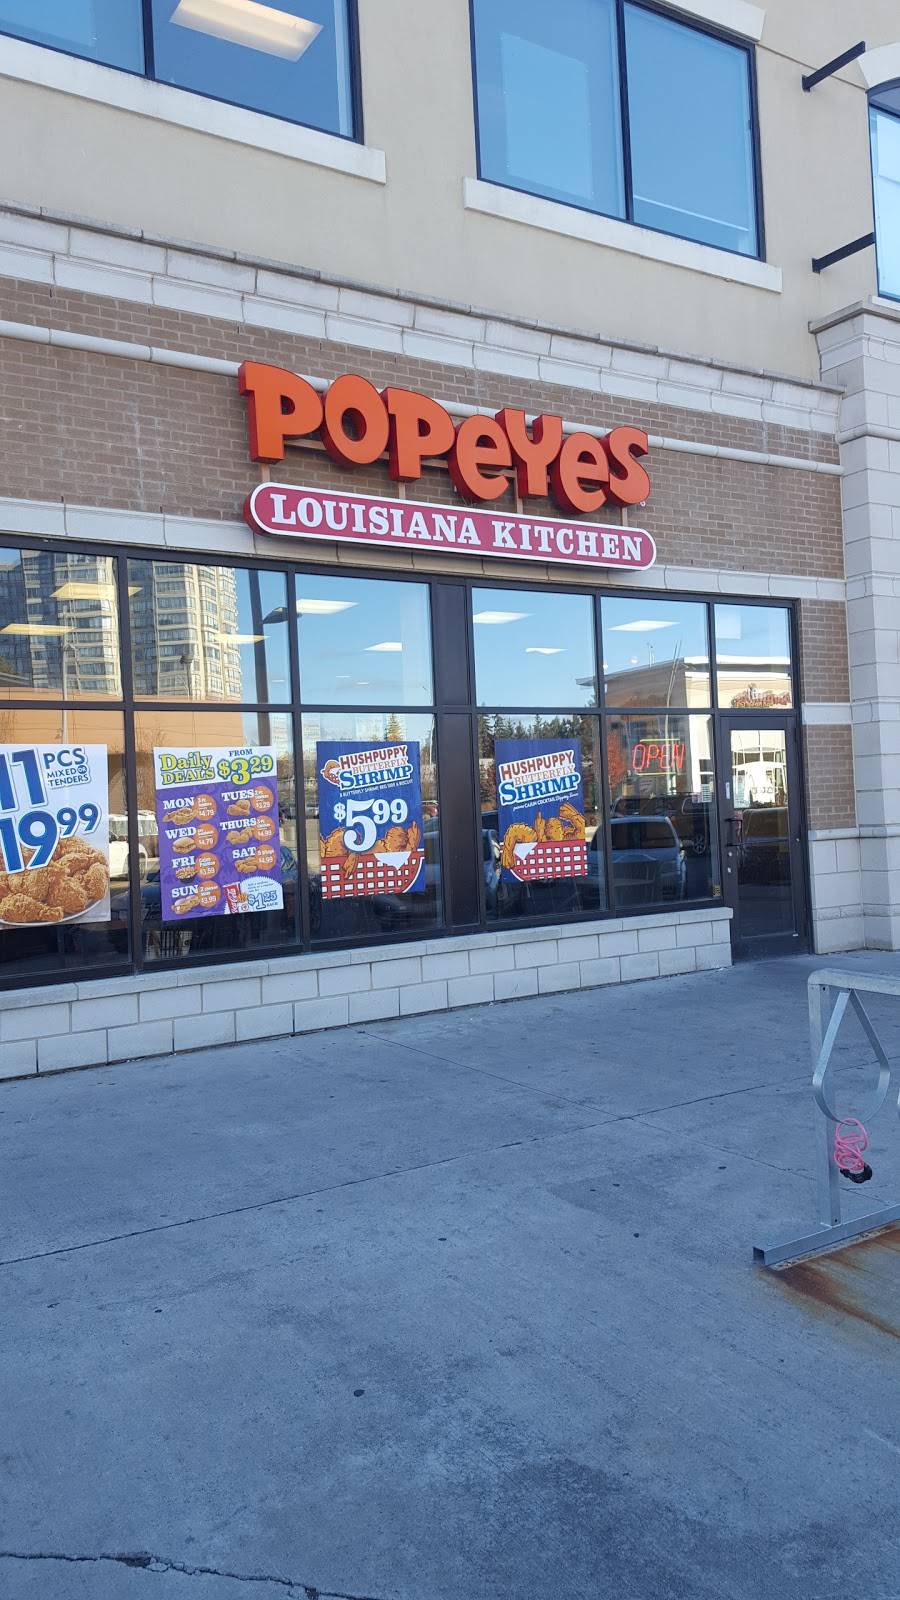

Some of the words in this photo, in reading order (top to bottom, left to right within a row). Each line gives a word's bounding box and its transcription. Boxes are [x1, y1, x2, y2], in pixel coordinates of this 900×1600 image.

[269, 493, 481, 546] LOUISIANA
[492, 520, 643, 562] KITCHEN
[43, 748, 85, 769] PCS
[229, 748, 253, 757] FROM
[340, 746, 406, 769] HUSHPUPPY
[632, 743, 686, 770] OPEN
[159, 752, 213, 772] Daily
[352, 758, 408, 774] BUTTERFLY
[501, 751, 573, 780] HUSHPUPPY
[47, 768, 76, 779] MIXED
[48, 774, 89, 786] TENDERS
[161, 767, 216, 785] DEALS
[339, 765, 413, 788] SHRIMP
[515, 765, 575, 785] BUTTERFLY
[221, 789, 254, 801] TUES
[500, 774, 580, 802] SHRIMP
[163, 797, 195, 809] MON
[219, 818, 257, 830] THURS
[165, 827, 197, 839] WED
[232, 847, 257, 859] SAT
[172, 856, 195, 868] FRI
[171, 885, 199, 898] SUN
